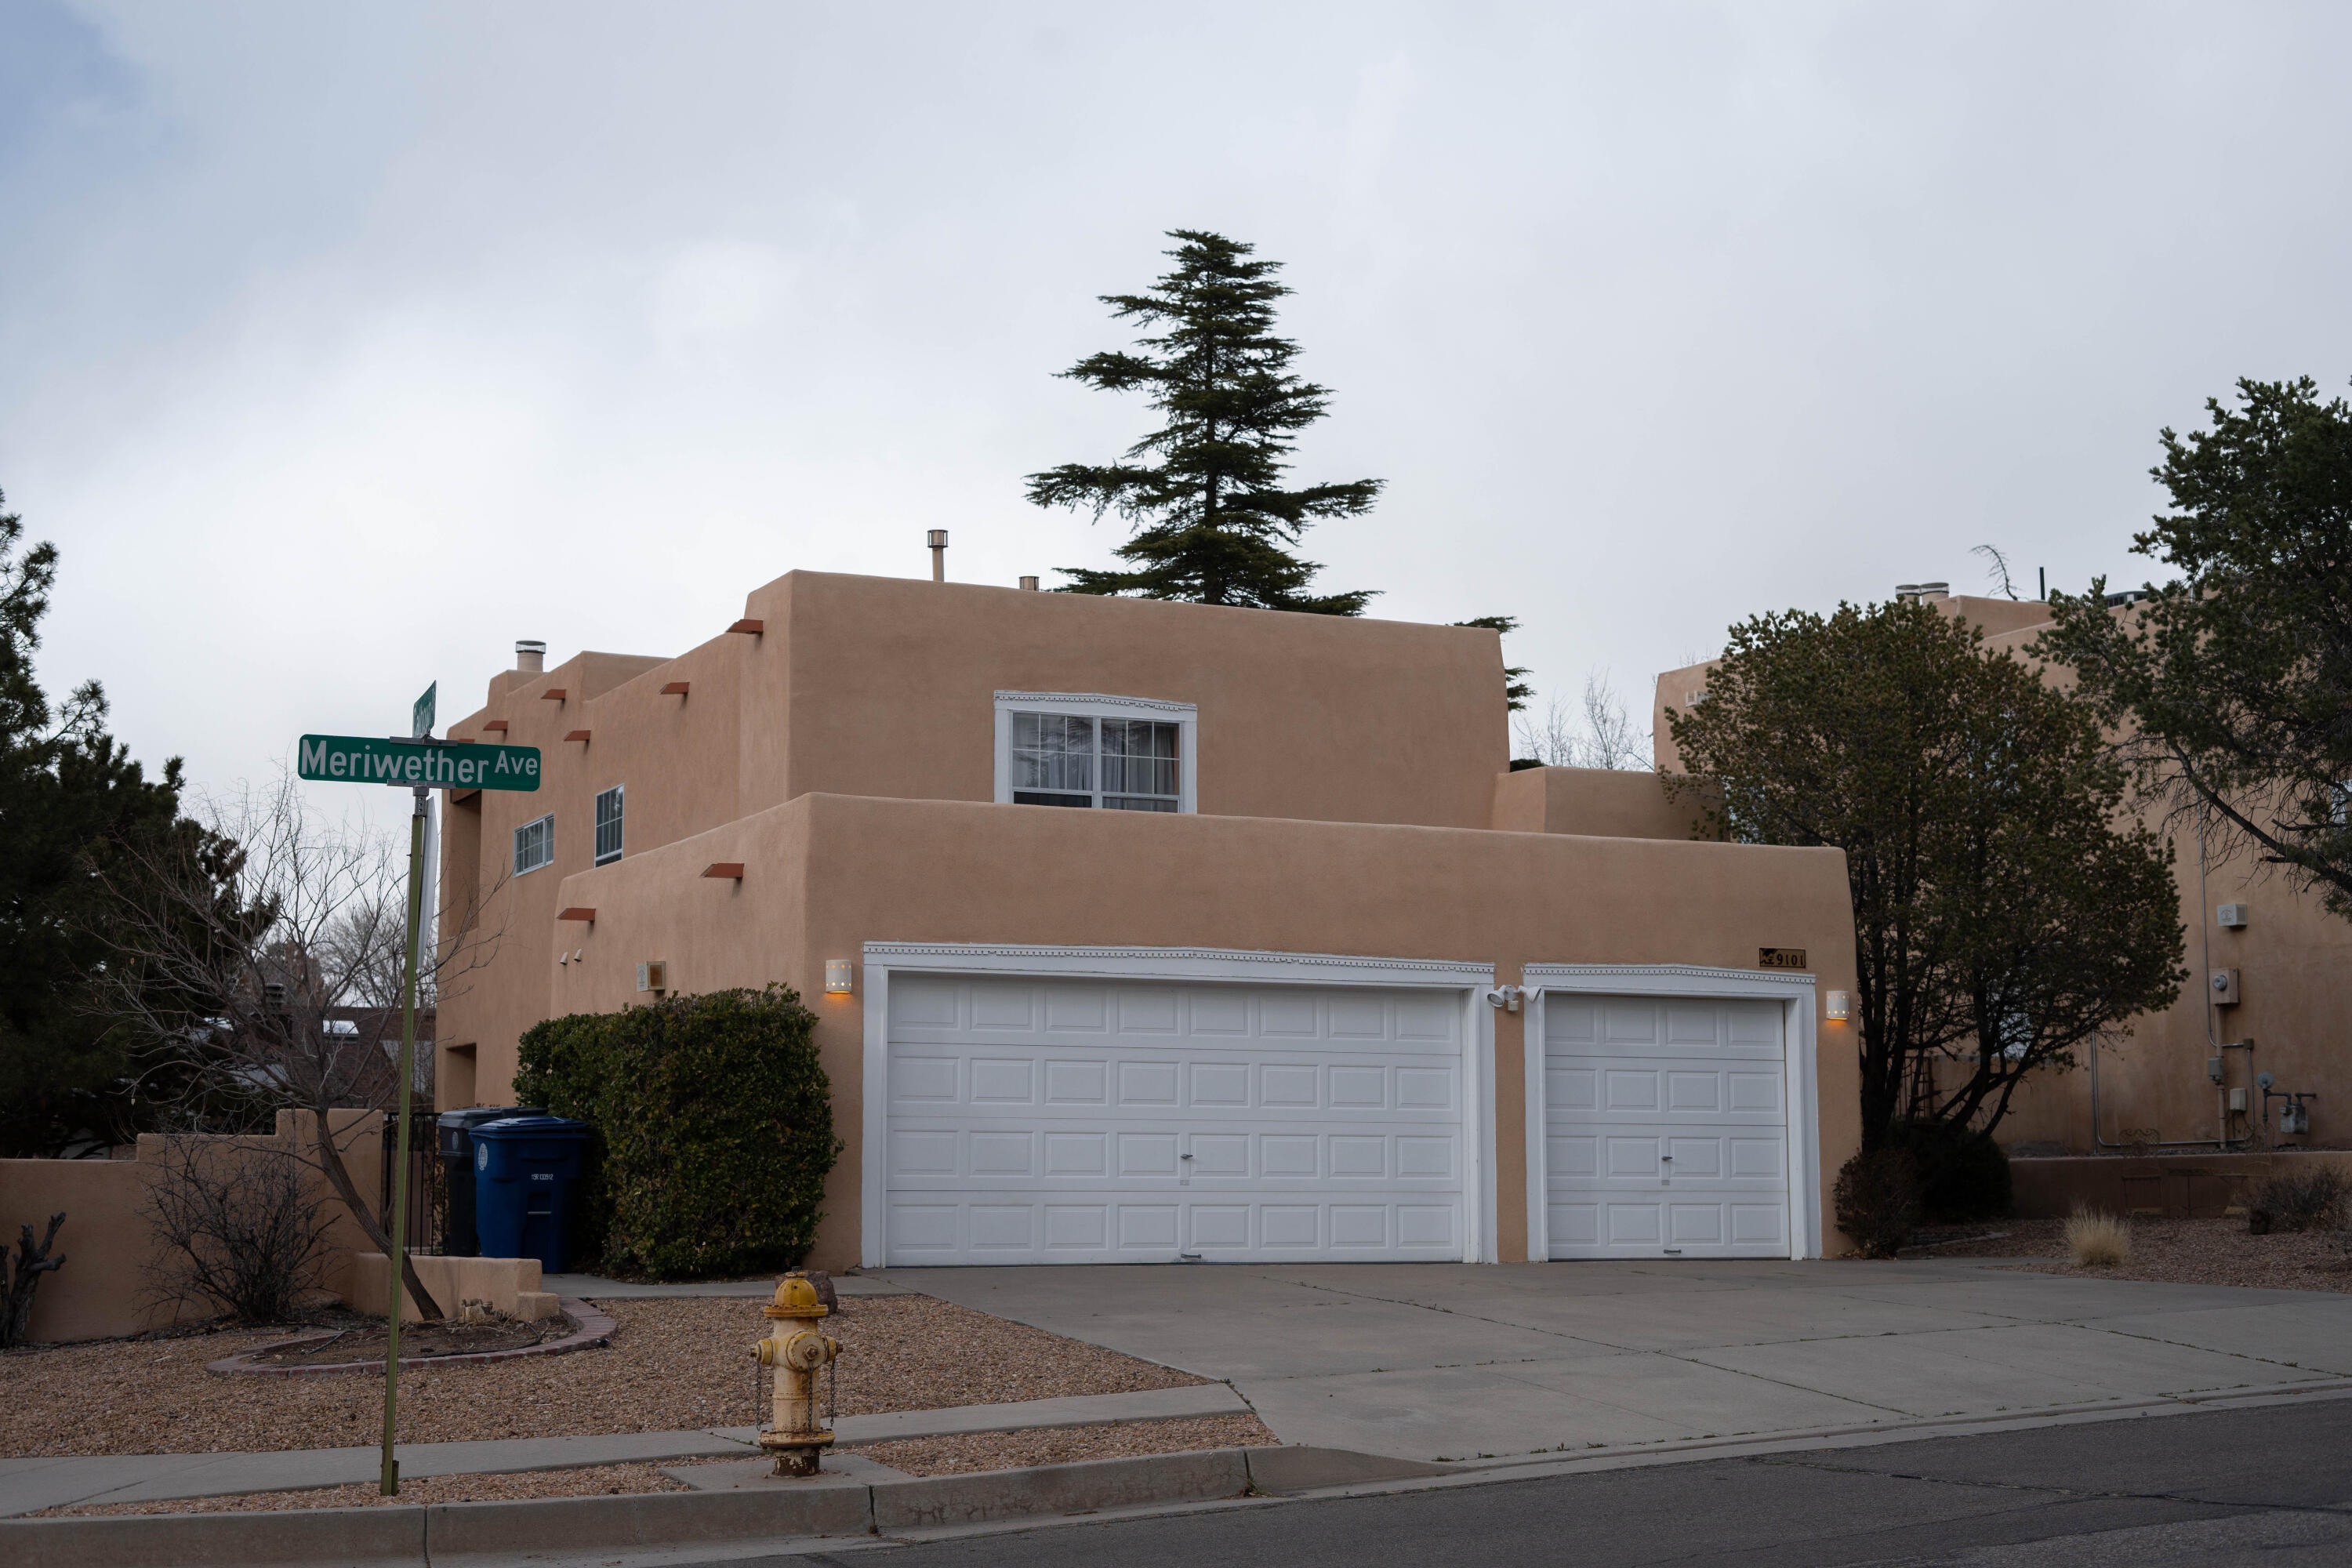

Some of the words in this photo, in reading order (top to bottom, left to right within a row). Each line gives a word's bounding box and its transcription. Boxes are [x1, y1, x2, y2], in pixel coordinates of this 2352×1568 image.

[301, 739, 489, 783] Meriwether
[495, 750, 538, 776] Ave
[1777, 953, 1803, 966] 9101
